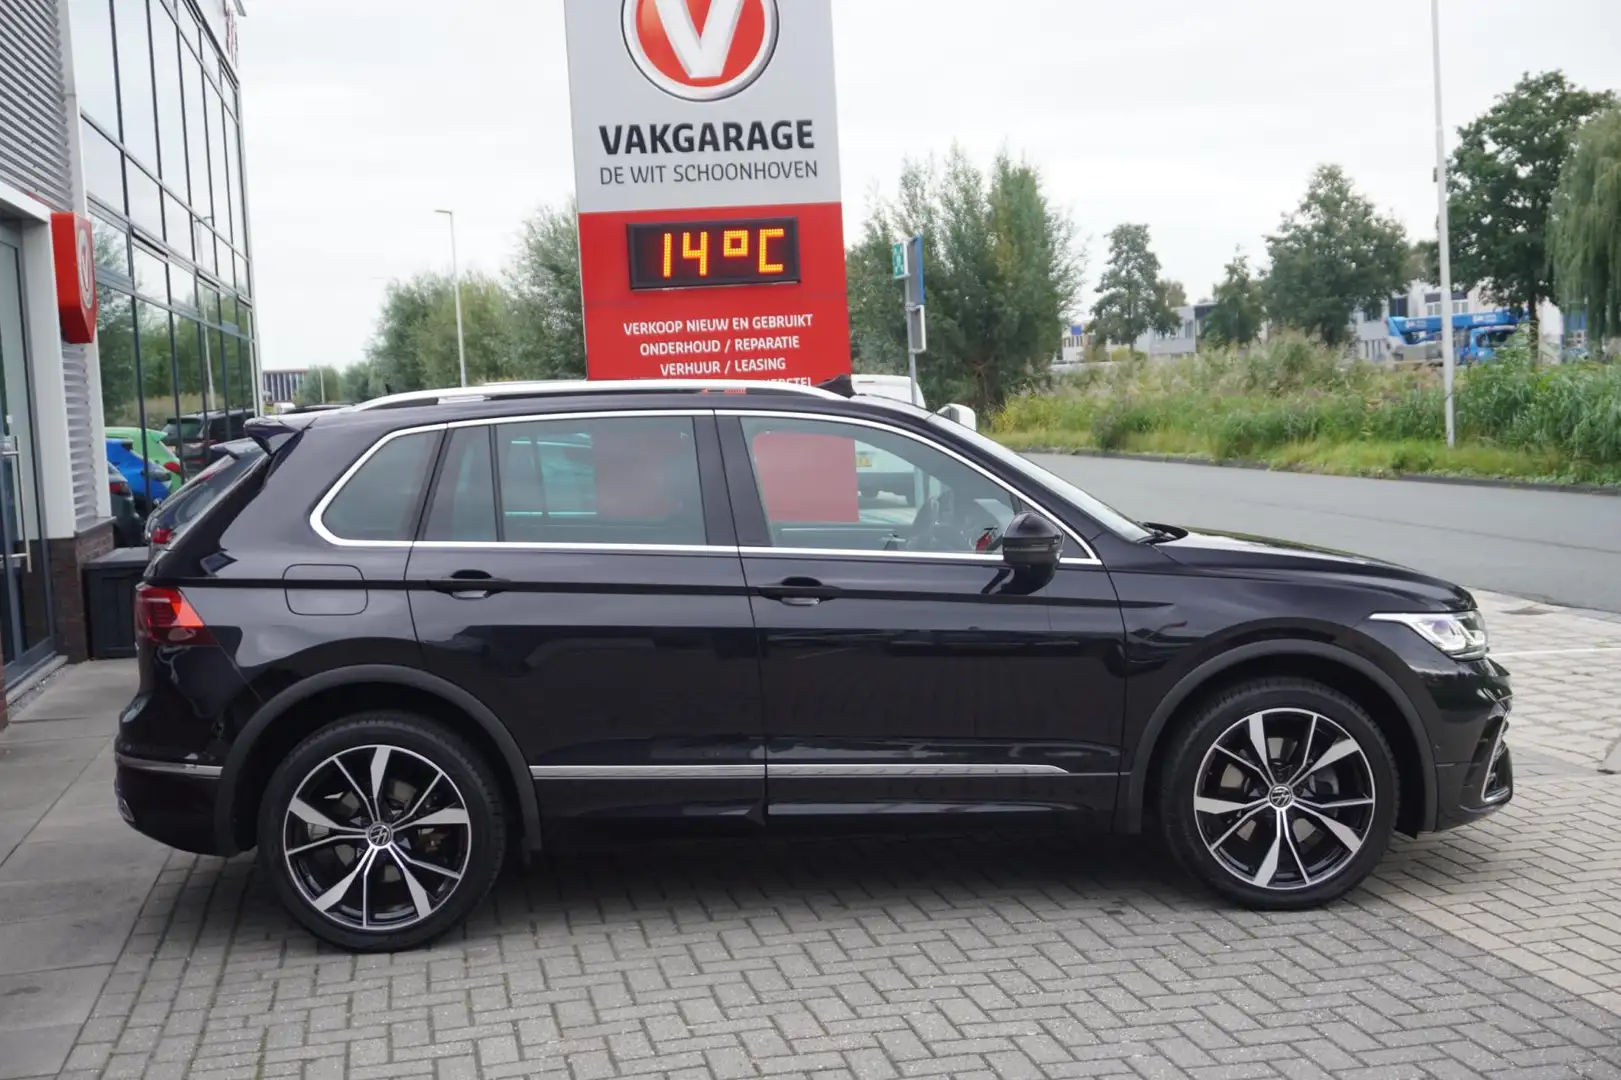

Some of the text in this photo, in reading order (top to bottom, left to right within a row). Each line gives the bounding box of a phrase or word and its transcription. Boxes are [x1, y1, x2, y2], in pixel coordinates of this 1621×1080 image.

[599, 120, 815, 155] VAKGARAGE
[600, 160, 818, 185] DE WIT SCHOONHOVEN
[623, 314, 813, 336] VERKOOP NIEUW EN GEBRUIKT
[640, 340, 721, 356] ONDERHOUD
[734, 336, 800, 351] REPARATIE
[660, 361, 721, 376] VERHUUR
[734, 357, 786, 373] LEASING
